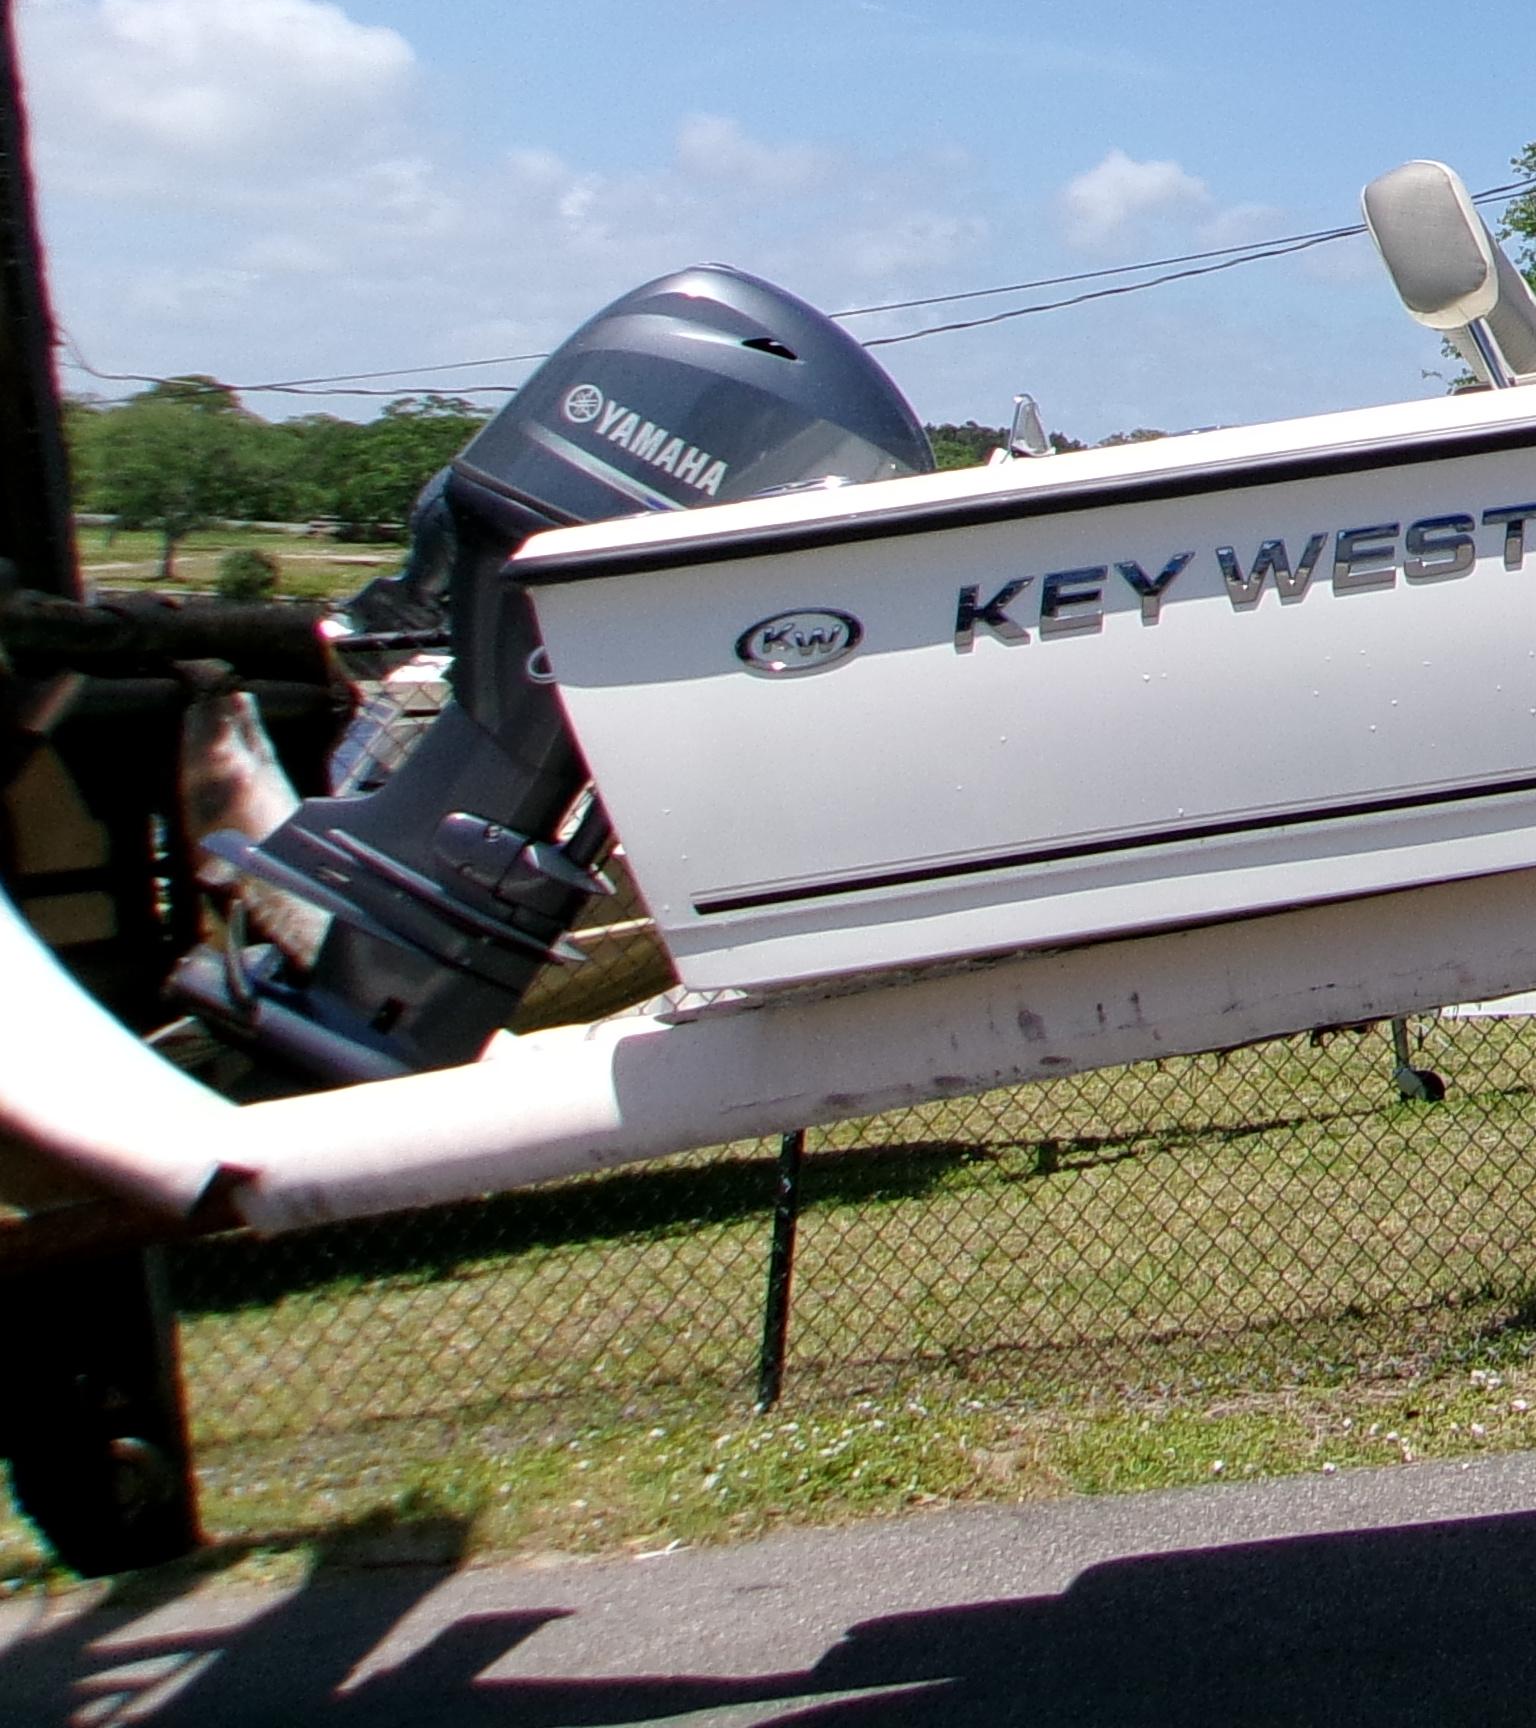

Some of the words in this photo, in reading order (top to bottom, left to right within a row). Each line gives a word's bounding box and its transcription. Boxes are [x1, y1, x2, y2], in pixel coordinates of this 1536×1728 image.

[596, 400, 728, 496] YAMAHA
[762, 623, 843, 656] KW
[953, 551, 1196, 653] KEY
